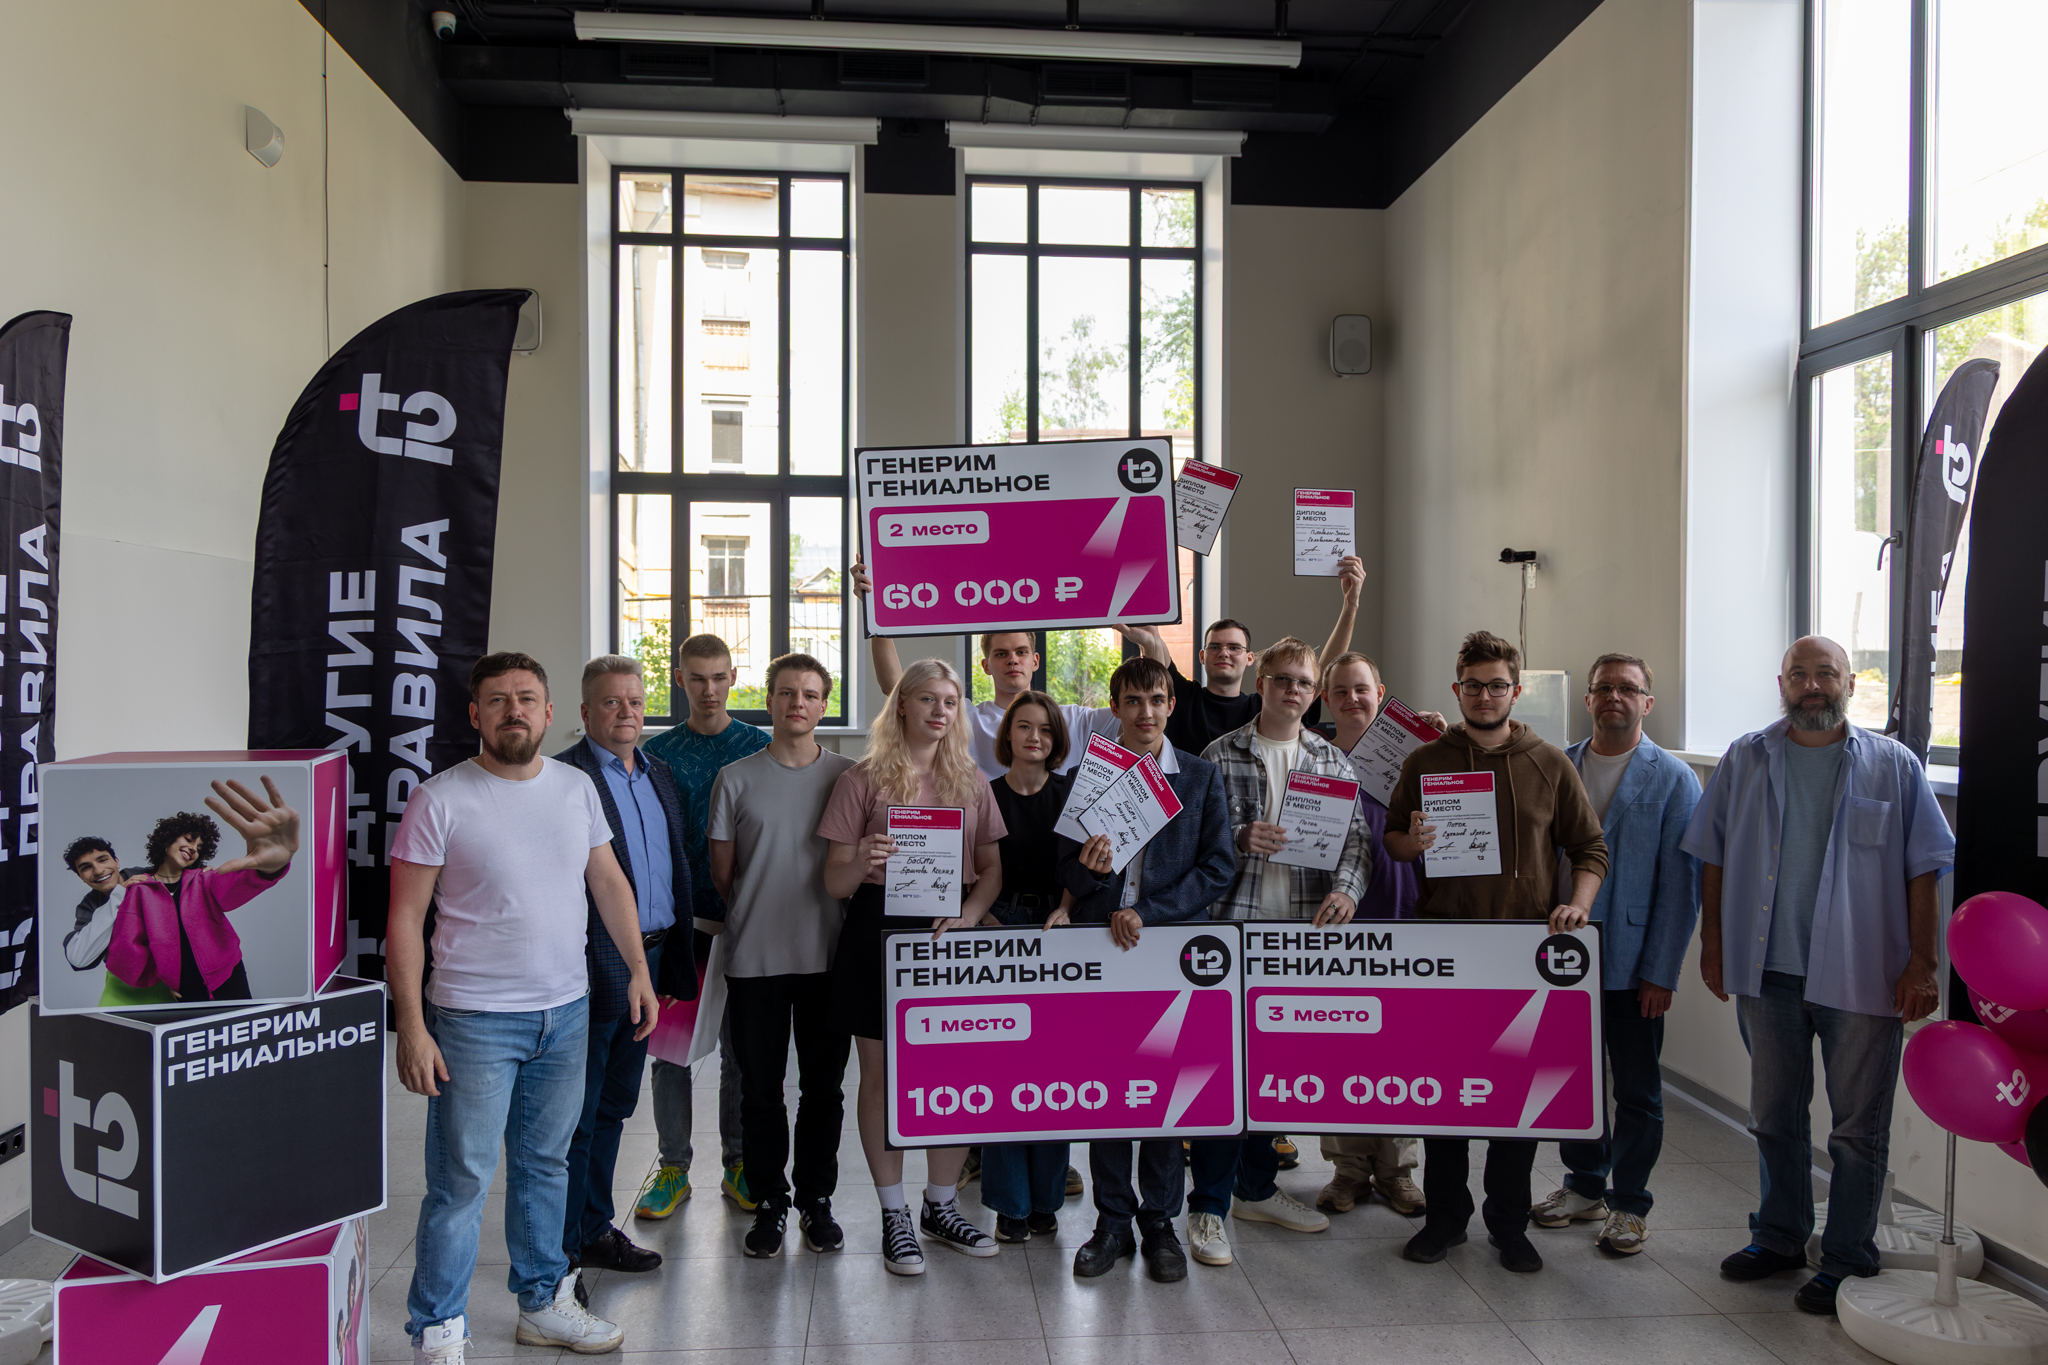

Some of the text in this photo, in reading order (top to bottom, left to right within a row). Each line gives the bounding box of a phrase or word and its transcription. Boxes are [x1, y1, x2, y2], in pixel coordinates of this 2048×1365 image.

[866, 454, 997, 476] ГЕНЕРИМ
[867, 473, 1051, 498] ГЕНИАЛЬНОЕ
[1178, 477, 1207, 490] ДИПЛОМ
[1182, 485, 1205, 496] МЕСТО
[889, 522, 979, 537] 2 место
[882, 581, 939, 610] 60
[954, 577, 1041, 607] 000
[19, 523, 49, 857] ПРАВИЛА
[1388, 704, 1420, 728] ГЕНИАЛЬНОЕ
[1390, 700, 1414, 719] ГЕНЕРИМ
[1377, 717, 1407, 740] ДИПЛОМ
[1380, 726, 1404, 744] МЕСТО
[1090, 740, 1123, 760] ГЕНИАЛЬНОЕ
[1091, 736, 1116, 751] ГЕНЕРИМ
[1083, 757, 1114, 777] ДИПЛОМ
[1086, 767, 1111, 782] МЕСТО
[1143, 759, 1165, 792] ГЕНИАЛЬНОЕ
[1145, 755, 1162, 780] ГЕНЕРИМ
[1128, 770, 1150, 801] ДИПЛОМ
[1290, 777, 1330, 789] ГЕНИАЛЬНОЕ
[1291, 773, 1320, 782] ГЕНЕРИМ
[1128, 779, 1144, 804] МЕСТО
[1286, 794, 1322, 806] ДИПЛОМ
[1293, 802, 1321, 812] МЕСТО
[1424, 799, 1460, 807] ДИПЛОМ
[1299, 818, 1318, 827] Поток
[889, 833, 927, 841] ДИПЛОМ
[895, 938, 1042, 962] ГЕНЕРИМ
[1246, 931, 1393, 951] ГЕНЕРИМ
[895, 962, 1102, 987] ГЕНИАЛЬНОЕ
[1246, 957, 1455, 977] ГЕНИАЛЬНОЕ
[1268, 1006, 1370, 1022] 3 место
[168, 1007, 320, 1058] ГЕНЕРИМ
[921, 1017, 1016, 1033] 1 место
[168, 1021, 376, 1087] ГЕНИАЛЬНОЕ
[908, 1084, 994, 1116] 100
[1011, 1080, 1108, 1112] 000
[1258, 1074, 1325, 1104] 40
[1342, 1075, 1442, 1106] 000
